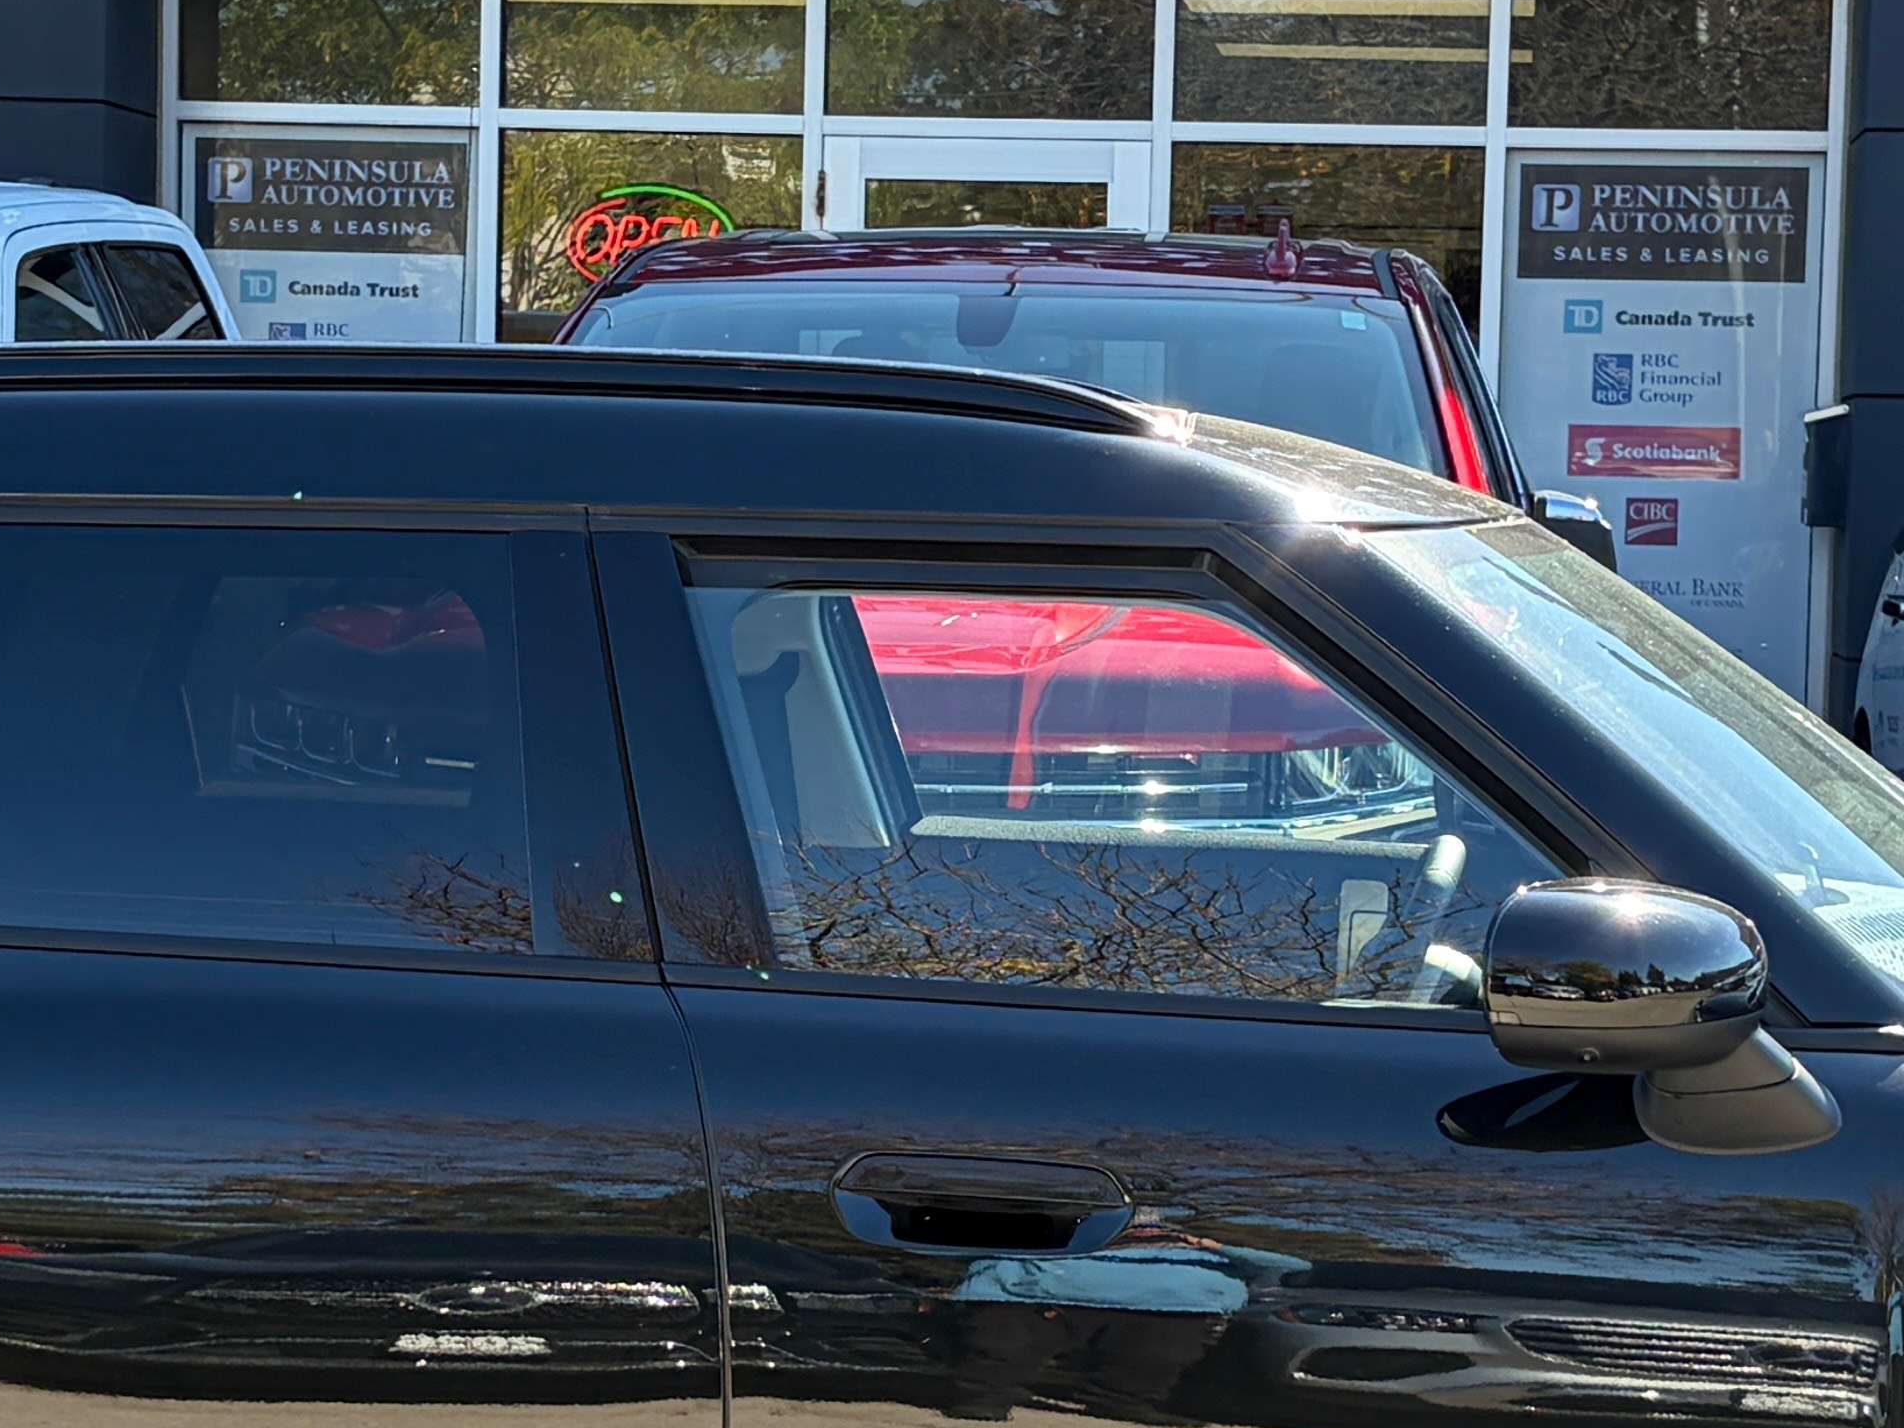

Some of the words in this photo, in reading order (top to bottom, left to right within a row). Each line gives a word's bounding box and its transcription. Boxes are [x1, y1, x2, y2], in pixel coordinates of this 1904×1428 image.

[262, 157, 452, 184] PENINSULA
[260, 184, 456, 209] AUTOMOTIVE
[1591, 184, 1793, 210] PENINSULA
[1539, 186, 1575, 228] P
[228, 217, 299, 234] SALES
[309, 219, 323, 235] &
[333, 219, 433, 237] LEASING
[1588, 211, 1796, 236] AUTOMOTIVE
[1552, 245, 1629, 262] SALES
[1639, 247, 1653, 263] &
[1664, 247, 1771, 265] LEASING
[243, 275, 273, 298] TD
[287, 280, 362, 299] Canada
[366, 282, 421, 300] Trust
[1567, 304, 1600, 329] TD
[1614, 310, 1693, 328] Canada
[1698, 312, 1756, 329] Trust
[313, 322, 350, 338] RBC
[1640, 353, 1680, 369] RBC
[1640, 370, 1722, 387] Financial
[1595, 388, 1632, 404] RBC
[1638, 388, 1695, 409] Group
[1611, 442, 1721, 461] Scotiabank
[1628, 501, 1676, 522] CIBC
[1633, 580, 1687, 596] ERAL
[1692, 578, 1744, 598] BANK
